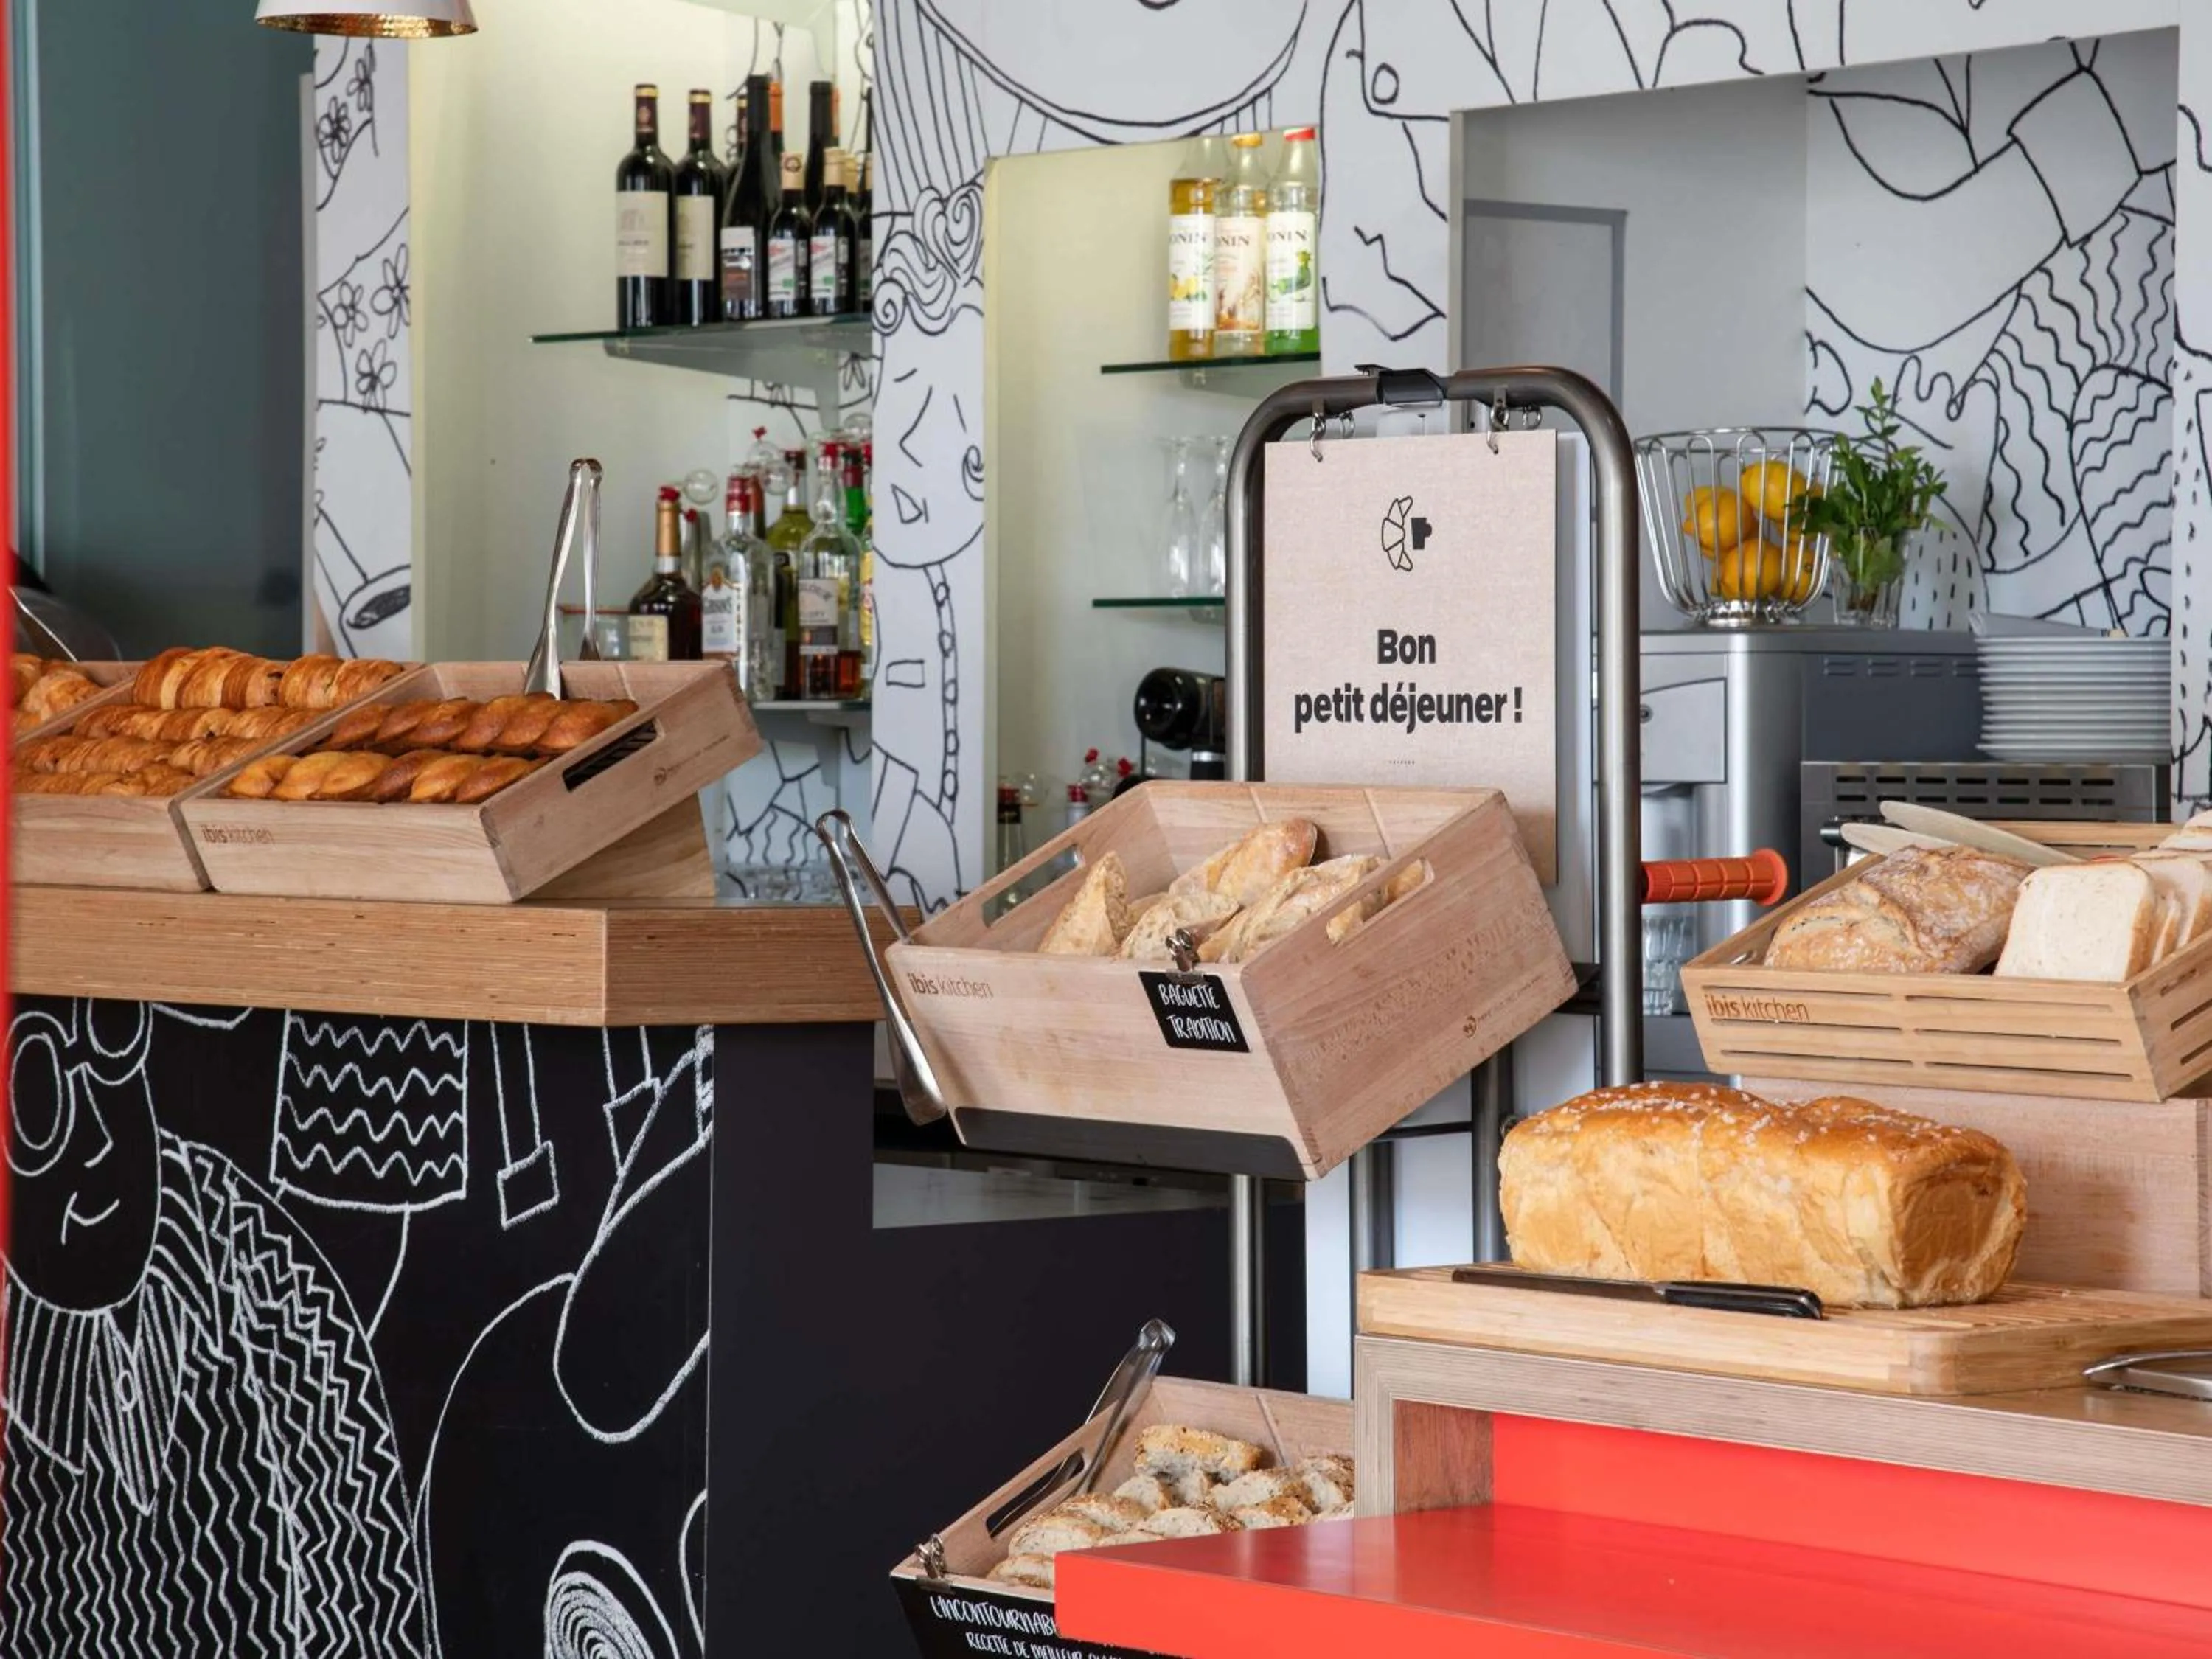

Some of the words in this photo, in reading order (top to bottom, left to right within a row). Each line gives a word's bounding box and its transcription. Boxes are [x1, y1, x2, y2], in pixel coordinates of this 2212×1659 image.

[1377, 628, 1436, 664] Bon
[1294, 682, 1365, 734] petit
[201, 824, 228, 844] ibis
[907, 972, 939, 995] ibis
[937, 975, 994, 998] kitchen
[1158, 982, 1220, 1009] BAGUETTE
[1703, 995, 1740, 1018] ibis
[1741, 995, 1811, 1023] kitchen
[1166, 1014, 1237, 1043] TRADITION
[966, 1631, 1012, 1656] RECETTE
[1013, 1640, 1030, 1658] DE
